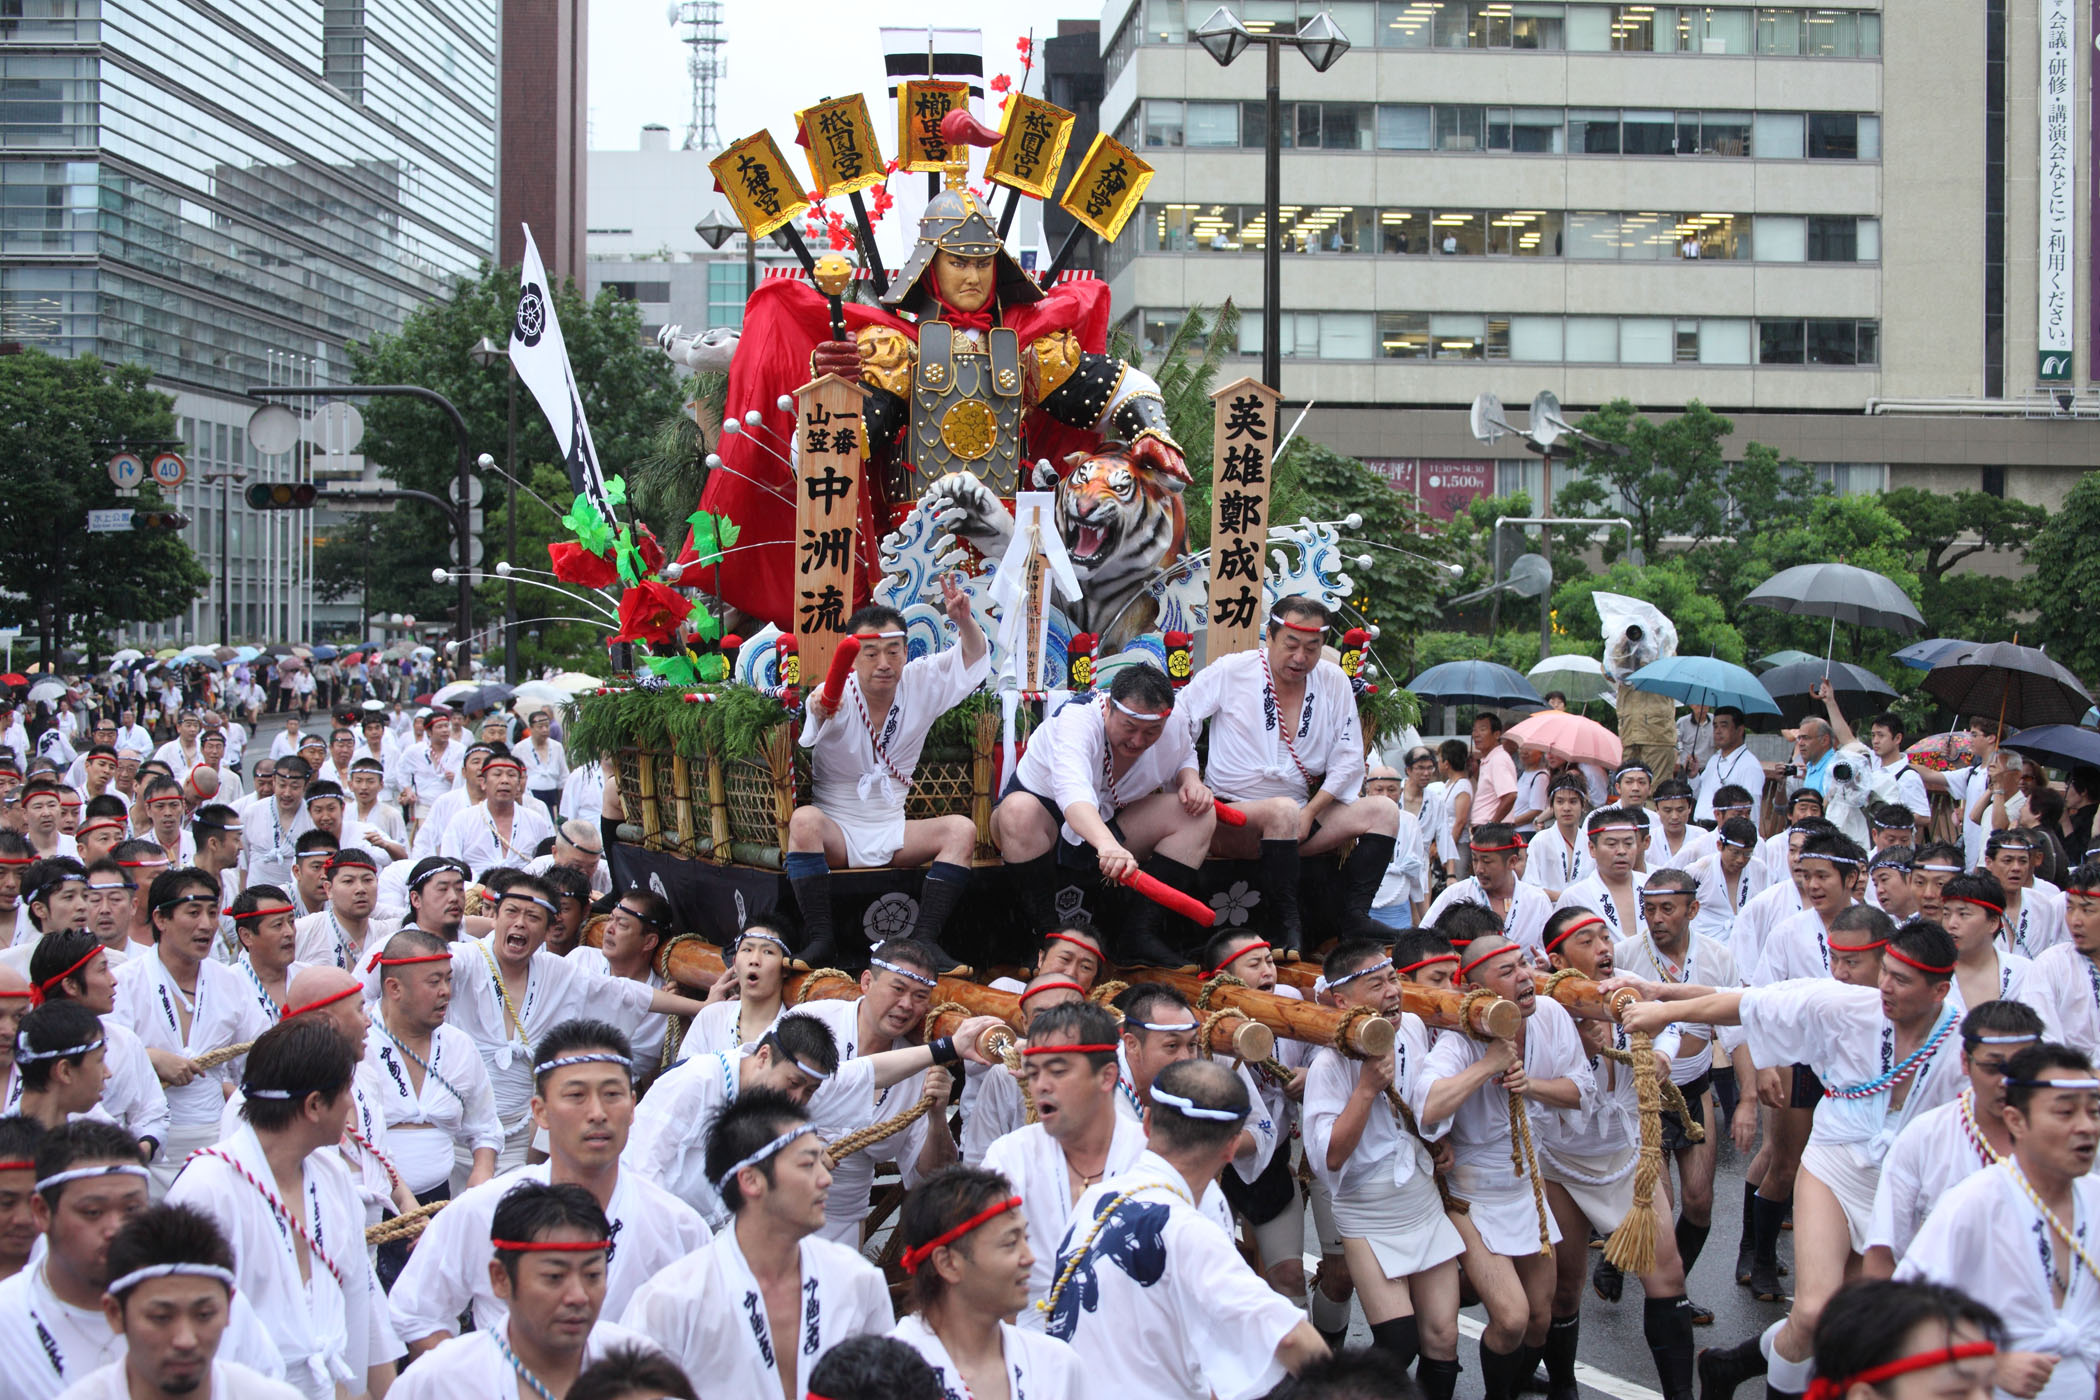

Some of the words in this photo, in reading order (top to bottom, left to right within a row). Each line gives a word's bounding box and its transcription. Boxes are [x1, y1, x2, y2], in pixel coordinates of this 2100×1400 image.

[2047, 0, 2068, 347] 会議・研修・講演会などにご利用ください。
[159, 462, 179, 478] 40
[805, 403, 831, 453] 山笠
[830, 411, 859, 456] 一番
[799, 466, 853, 634] 中洲流
[1213, 394, 1268, 629] 英雄鄭成功
